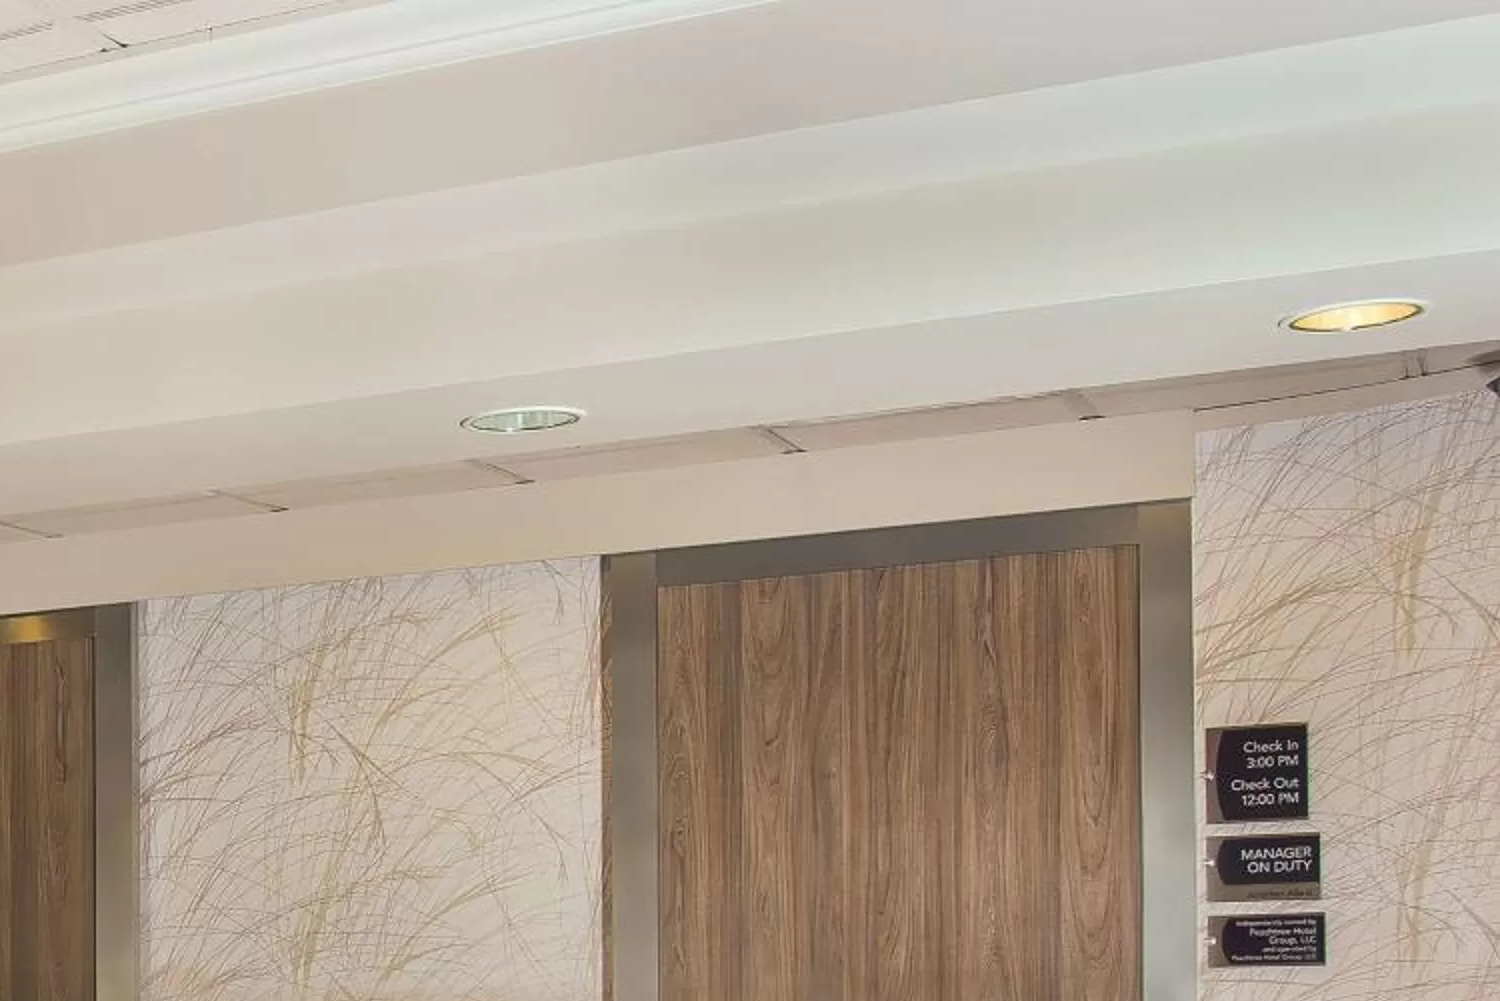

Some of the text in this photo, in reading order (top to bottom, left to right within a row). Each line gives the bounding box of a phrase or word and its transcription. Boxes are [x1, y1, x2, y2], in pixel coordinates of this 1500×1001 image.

[1243, 739, 1299, 753] Check In
[1247, 754, 1299, 769] 3:00 PM
[1231, 777, 1299, 791] Check Out
[1242, 792, 1299, 806] 12:00 PM
[1240, 845, 1313, 860] MANAGER
[1247, 859, 1313, 873] ON DUTY
